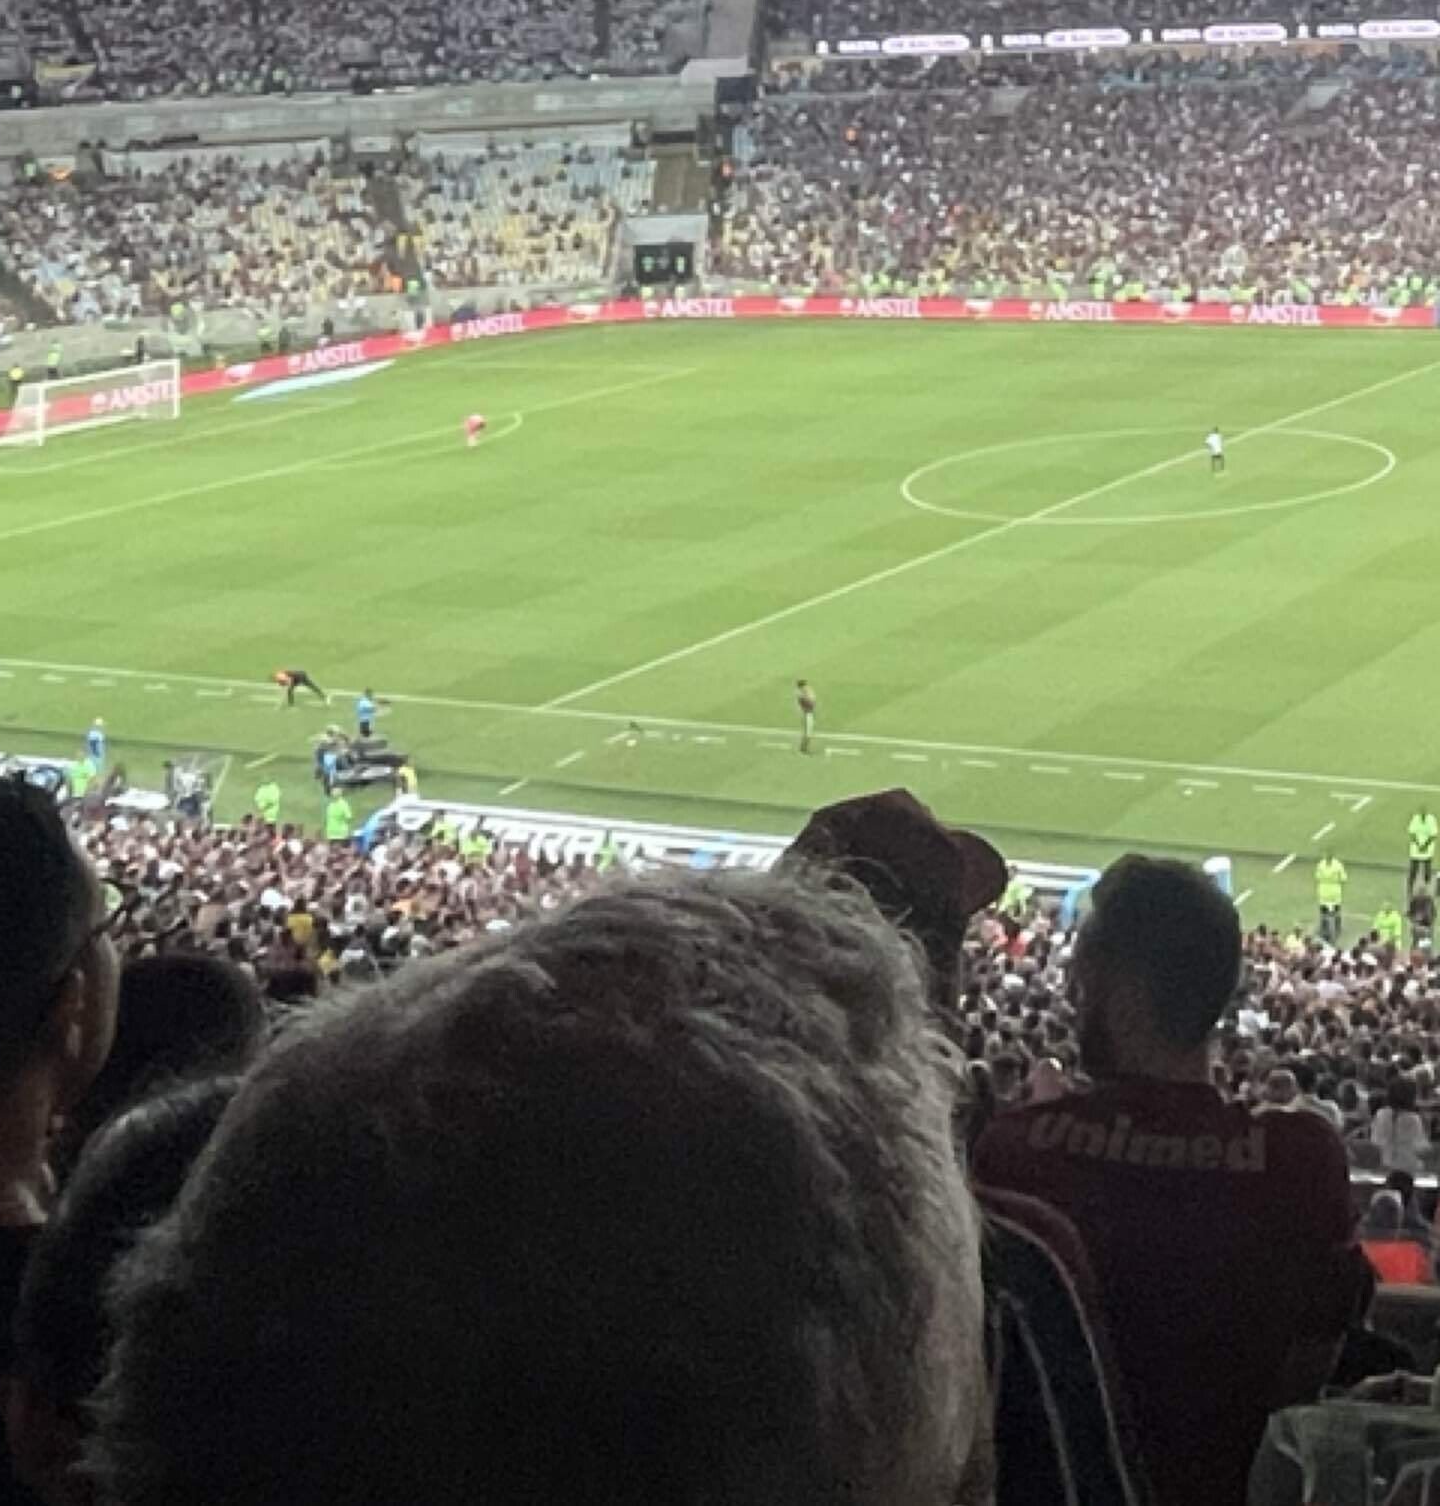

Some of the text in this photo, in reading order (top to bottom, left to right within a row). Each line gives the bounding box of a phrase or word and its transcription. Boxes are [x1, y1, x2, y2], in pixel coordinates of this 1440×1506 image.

[1248, 303, 1322, 325] AMSTEL
[109, 379, 180, 409] AMSTE
[1028, 1110, 1267, 1172] Unimed
